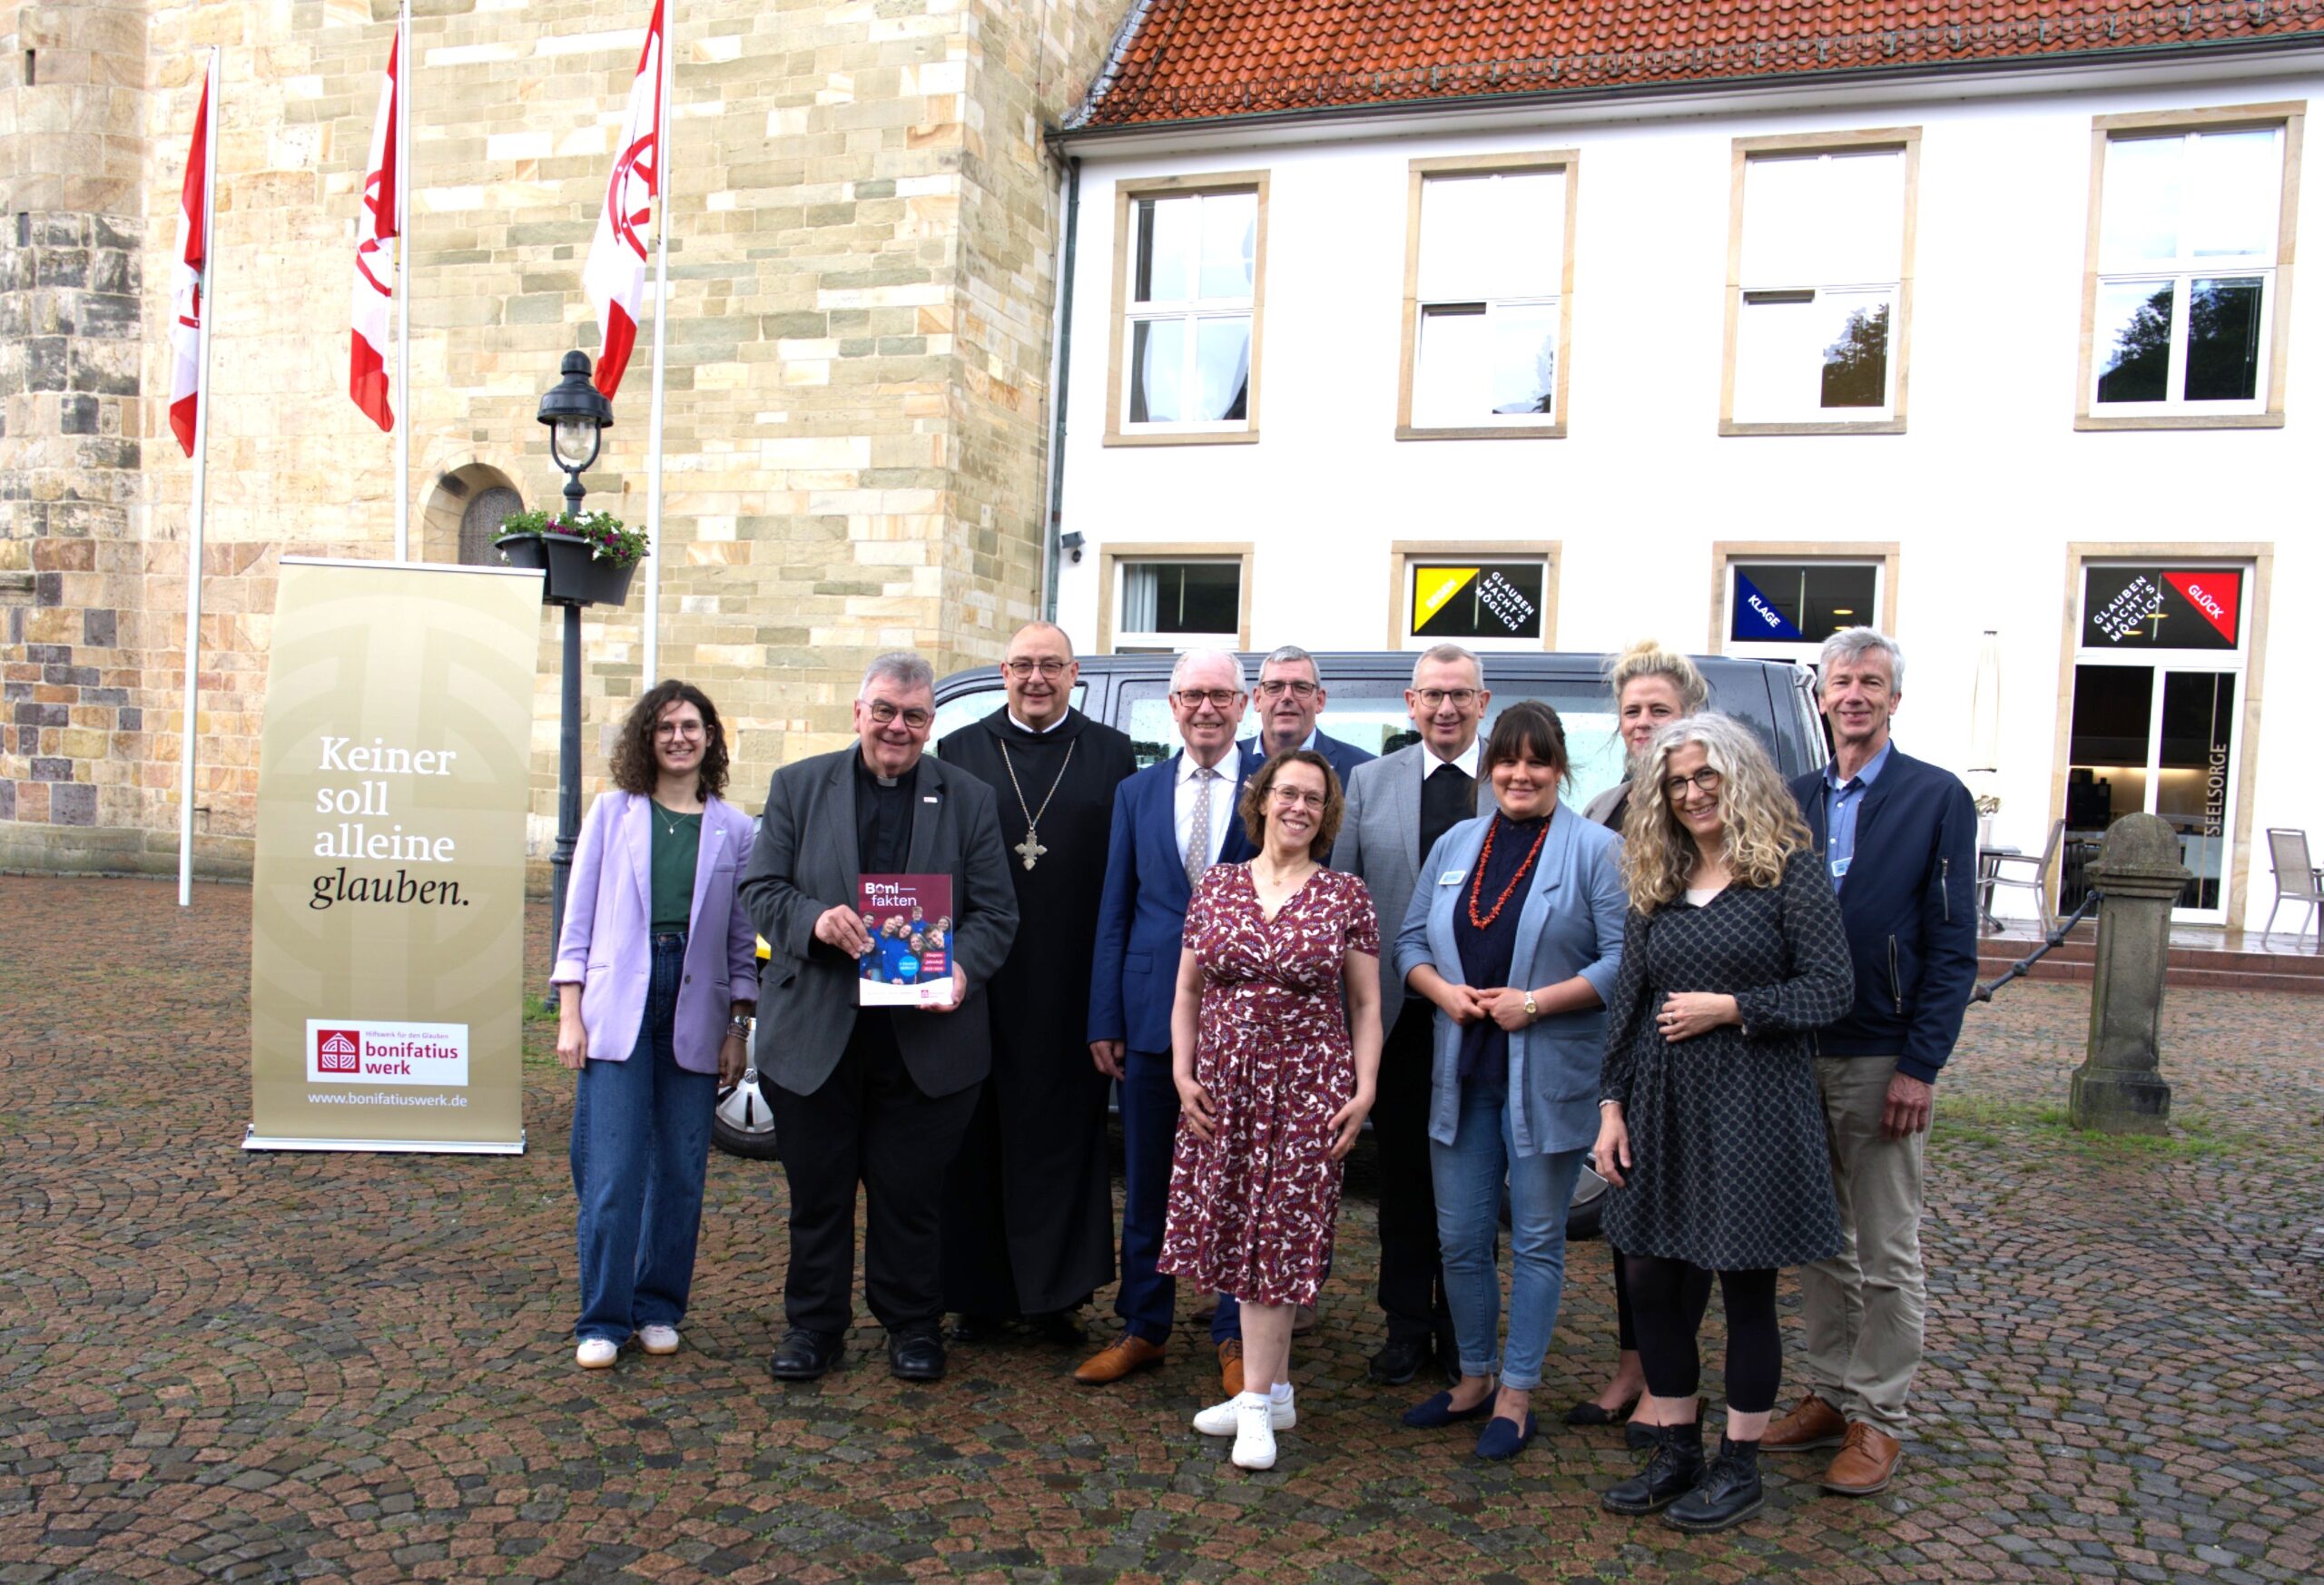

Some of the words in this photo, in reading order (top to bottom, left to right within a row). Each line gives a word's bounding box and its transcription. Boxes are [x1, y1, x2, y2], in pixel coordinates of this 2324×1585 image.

[1475, 586, 1519, 631] MÖGLICH
[1492, 571, 1535, 615] GLAUBEN
[1748, 594, 1781, 628] KLAGE
[2093, 576, 2147, 625] GLAUBEN
[2188, 585, 2224, 619] GLÜCK
[2110, 592, 2164, 642] MÖGLICH
[318, 736, 457, 775] Keiner
[316, 780, 389, 815] soll
[2205, 743, 2227, 835] SEELSORGE
[314, 822, 455, 862] alleine
[310, 867, 469, 910] glauben.
[872, 894, 917, 906] fakten
[366, 1030, 395, 1039] Hilfswerk
[366, 1041, 458, 1058] bonifatius
[366, 1060, 411, 1075] werk
[308, 1092, 468, 1107] www.bonifatiuswerk.de
